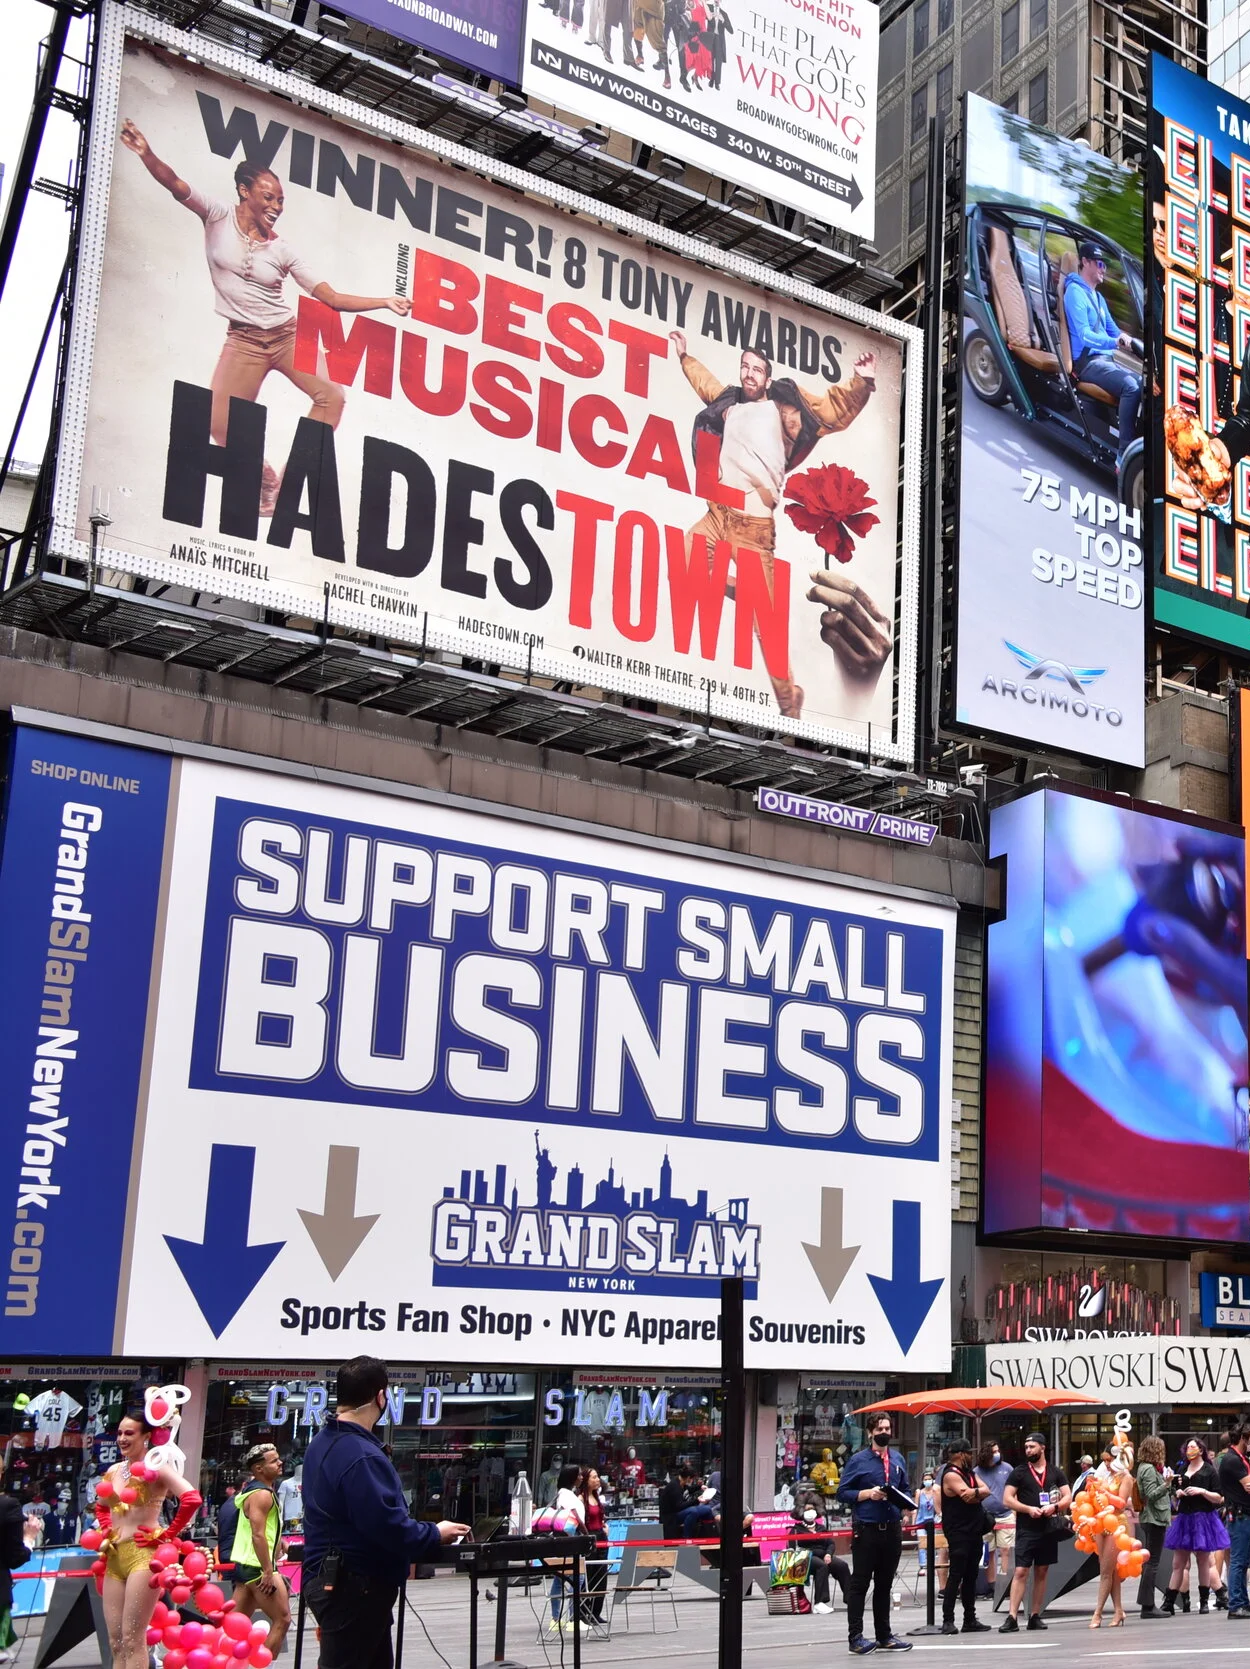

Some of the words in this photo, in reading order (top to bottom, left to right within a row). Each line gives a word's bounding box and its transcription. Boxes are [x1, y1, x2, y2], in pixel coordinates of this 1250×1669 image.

[784, 0, 862, 39] OMENON
[829, 0, 855, 18] HIT
[737, 29, 791, 67] THAT
[795, 57, 866, 109] GOES
[749, 10, 788, 44] THE
[795, 27, 856, 75] PLAY
[735, 53, 866, 146] WRONG
[568, 64, 606, 88] NEW
[608, 78, 663, 113] WORLD
[665, 107, 718, 139] STAGES
[727, 133, 753, 154] 340
[756, 146, 772, 163] W.
[804, 169, 852, 199] STREET
[736, 98, 858, 163] BROADWAYGOESWRONG.COM
[195, 89, 555, 277] WINNER!
[564, 237, 586, 290] 8
[598, 238, 693, 320] TONY
[702, 297, 843, 385] AWARDS
[394, 243, 410, 300] INCLUDING
[410, 247, 669, 400] BEST
[293, 295, 746, 511] MUSICAL
[163, 380, 792, 681] HADESTOWN
[1020, 468, 1062, 512] 75
[1069, 485, 1142, 540] MPH
[170, 543, 207, 567] ANAÏS
[212, 553, 270, 582] MITCHELL
[233, 546, 247, 556] BOOK
[248, 550, 255, 558] BY
[1073, 523, 1143, 573] TOP
[323, 580, 366, 606] RACHEL
[371, 593, 418, 619] CHAVKIN
[1031, 547, 1143, 610] SPEED
[458, 615, 545, 651] HADESTOWN.COM
[587, 649, 623, 671] WALTER
[626, 658, 651, 678] KERR
[654, 665, 696, 690] THEATRE,
[700, 677, 717, 694] 219
[720, 681, 730, 697] W.
[732, 685, 756, 704] 48TH
[759, 692, 772, 708] ST.
[981, 674, 1123, 727] ARCIMOTO
[31, 759, 79, 779] SHOP
[80, 771, 141, 795] ONLINE
[764, 791, 870, 830] OUTFRONT
[879, 818, 931, 843] PRIME
[233, 815, 665, 973] SUPPORT
[676, 896, 927, 1015] SMALL
[4, 801, 103, 1318] GrandSlamNewYork.com
[215, 915, 925, 1148] BUSINESS
[432, 1199, 620, 1272] GRAND
[622, 1211, 761, 1279] SLAM
[568, 1275, 600, 1290] NEW
[602, 1277, 636, 1292] YORK
[280, 1296, 387, 1336] Sports
[399, 1302, 450, 1336] Fan
[460, 1305, 532, 1341] Shop
[561, 1308, 616, 1338] NYC
[624, 1310, 724, 1345] Apparel
[748, 1315, 866, 1346] Souvenirs
[109, 1389, 123, 1405] 14
[989, 1352, 1155, 1390] SWAROVSKI
[42, 1407, 62, 1423] 45
[265, 1384, 443, 1426] GRND
[544, 1387, 669, 1427] SLAM
